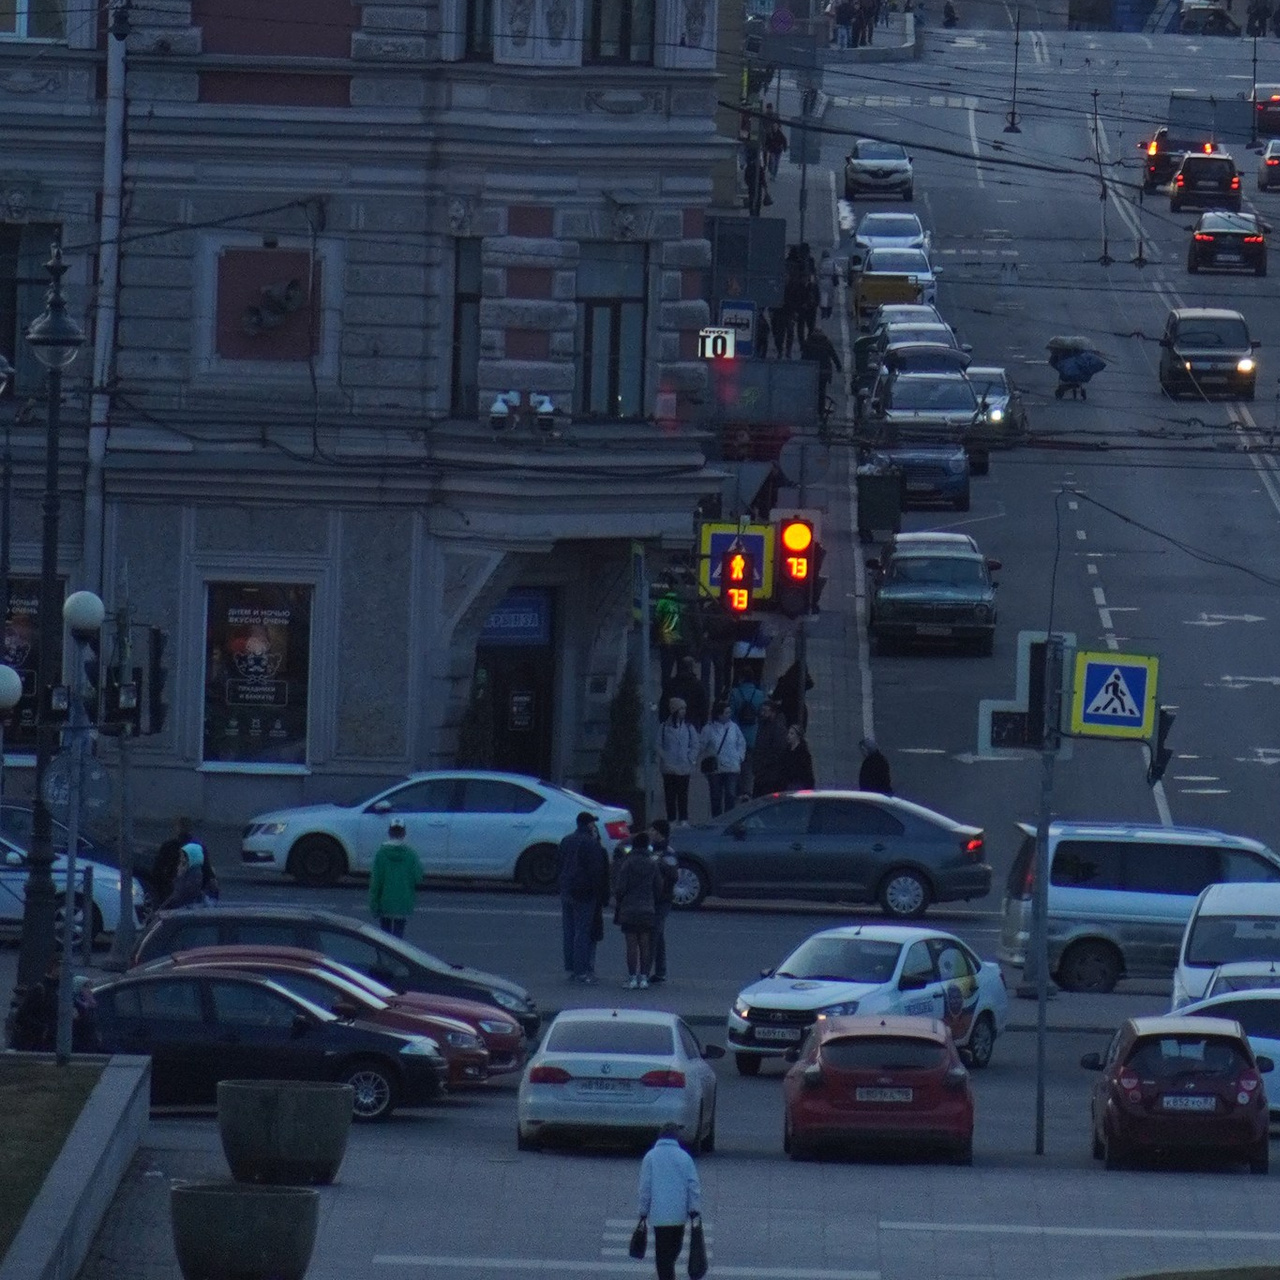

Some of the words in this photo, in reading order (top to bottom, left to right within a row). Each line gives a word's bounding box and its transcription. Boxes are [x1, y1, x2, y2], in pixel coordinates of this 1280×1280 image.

[787, 557, 808, 578] 73
[728, 588, 748, 609] 73
[228, 616, 262, 625] ВКУСНО
[264, 617, 290, 626] ОЧЕНЬ
[261, 609, 291, 619] НОЧЬЮ
